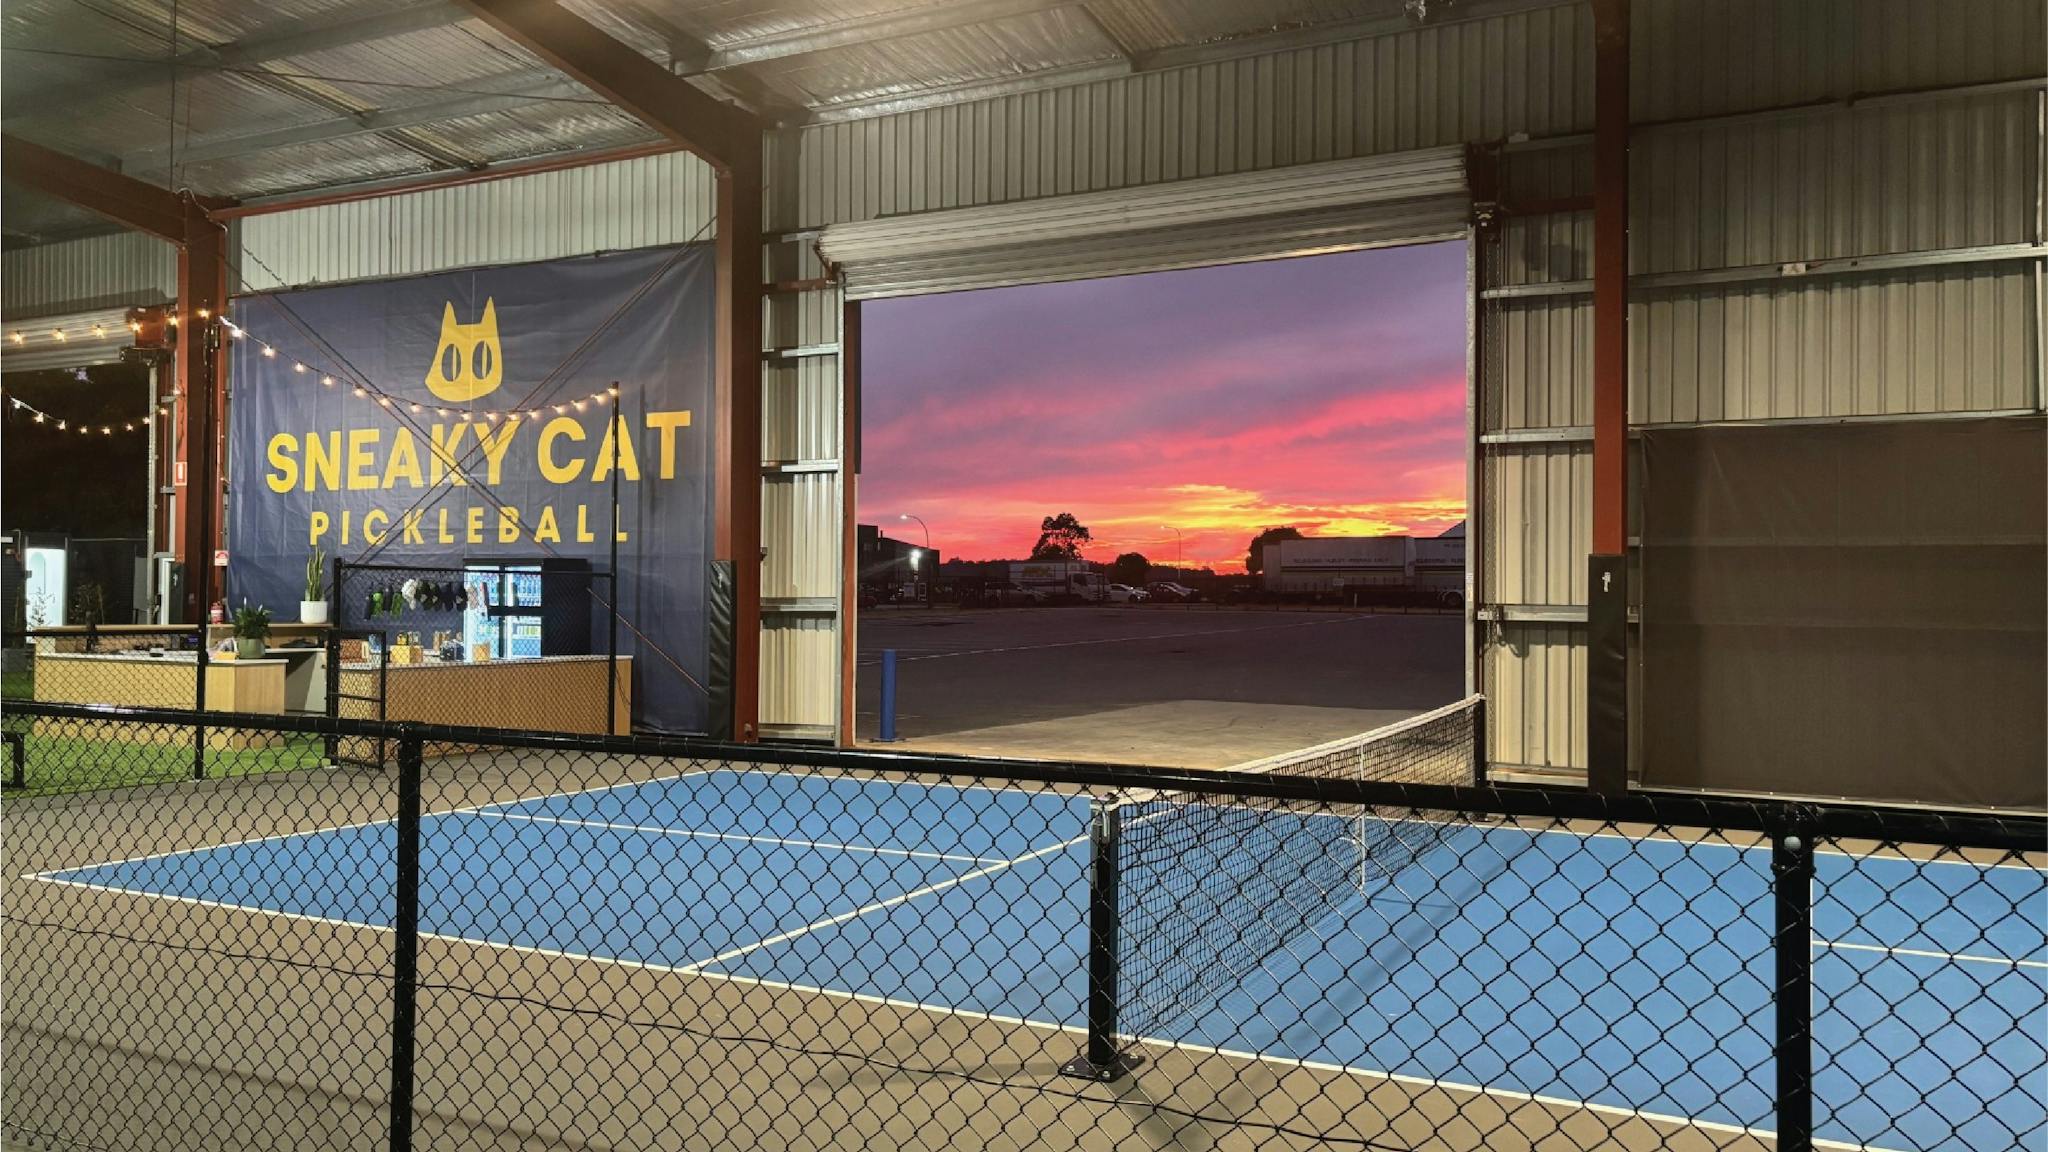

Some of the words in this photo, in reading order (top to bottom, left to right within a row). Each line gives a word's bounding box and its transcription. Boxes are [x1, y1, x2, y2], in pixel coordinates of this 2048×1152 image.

[266, 420, 521, 494] SNEAKY
[538, 411, 691, 484] CAT
[309, 504, 628, 545] PICKLEBALL
